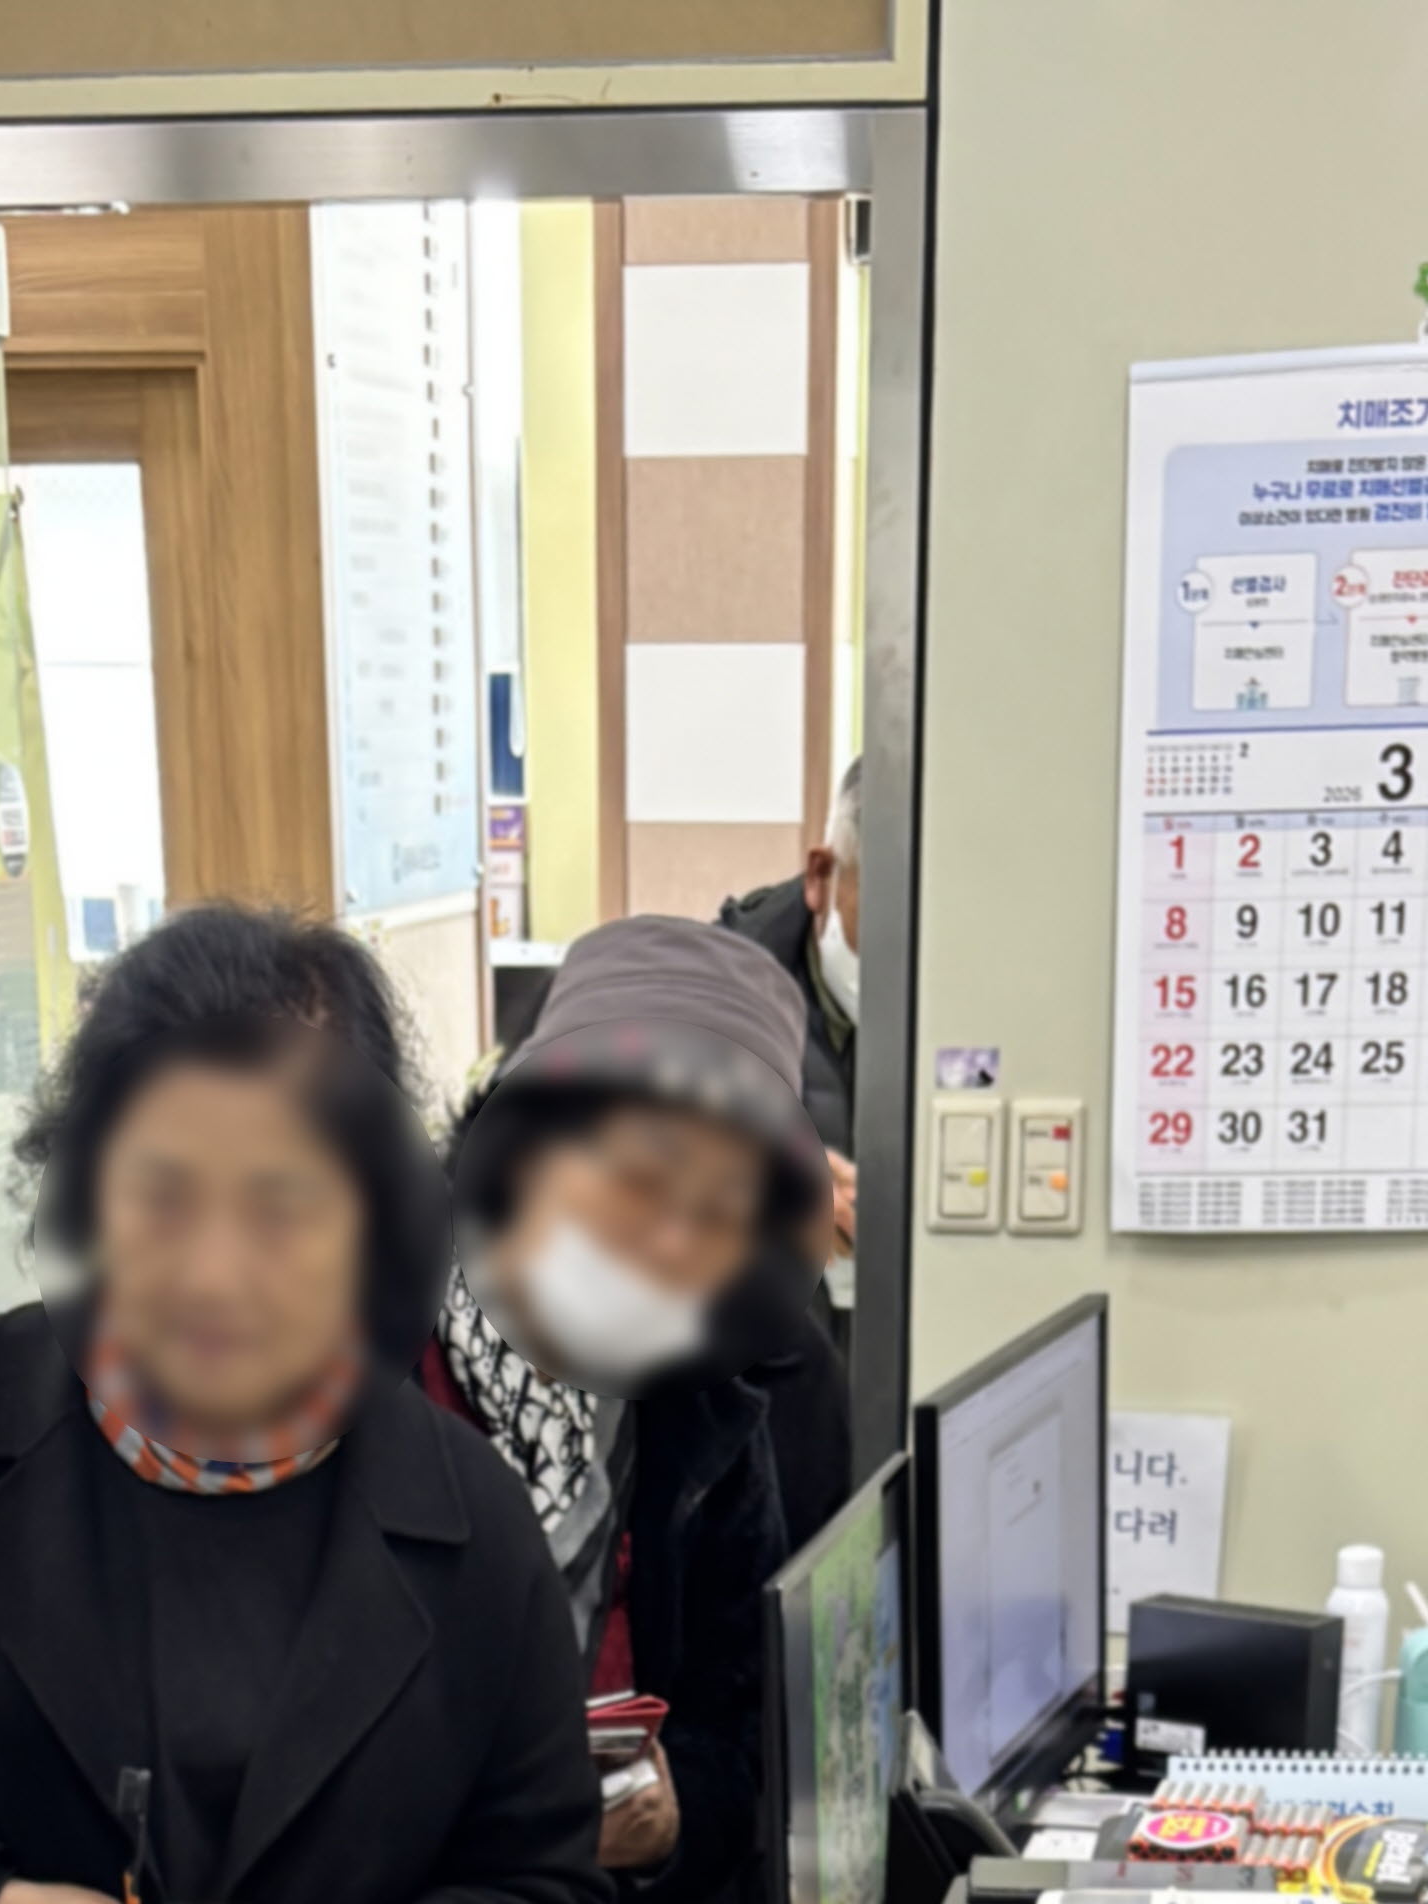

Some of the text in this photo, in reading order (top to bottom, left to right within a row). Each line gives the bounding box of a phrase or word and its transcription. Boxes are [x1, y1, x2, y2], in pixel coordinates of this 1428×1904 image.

[1253, 483, 1303, 502] 누구나
[1306, 481, 1355, 498] 무료로
[1378, 743, 1414, 802] 3
[1171, 835, 1184, 869] 1
[1238, 833, 1261, 868] 2
[1310, 831, 1332, 867] 3
[1382, 830, 1403, 864] 4
[1165, 906, 1187, 940] 8
[1236, 904, 1258, 939] 9
[1299, 902, 1341, 937] 10
[1372, 901, 1405, 935] 11
[1156, 975, 1196, 1009] 15
[1226, 973, 1267, 1008] 16
[1296, 972, 1338, 1006] 17
[1367, 971, 1408, 1006] 18
[1151, 1044, 1195, 1077] 22
[1221, 1043, 1264, 1077] 23
[1291, 1042, 1333, 1075] 24
[1361, 1040, 1404, 1074] 25
[1150, 1110, 1326, 1145] 29 30 31
